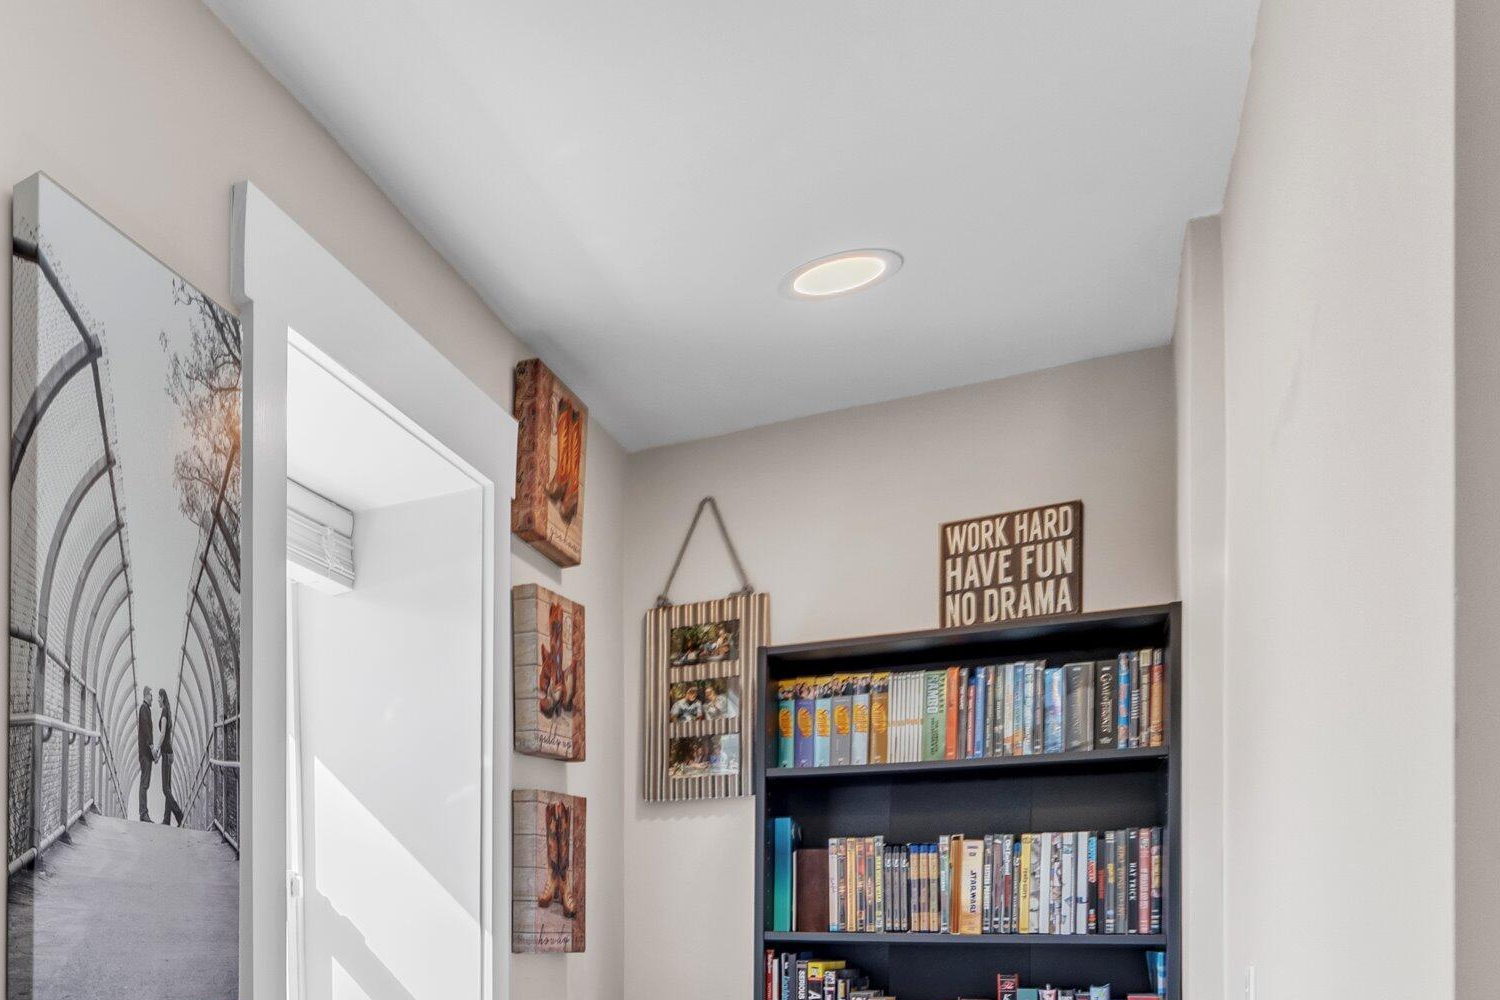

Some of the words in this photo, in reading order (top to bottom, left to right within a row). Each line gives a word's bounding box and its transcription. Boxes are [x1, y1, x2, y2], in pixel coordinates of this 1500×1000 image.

[946, 516, 1009, 555] WORK
[1014, 505, 1073, 545] HARD
[945, 548, 1014, 592] HAVE
[1021, 538, 1074, 581] FUN
[945, 591, 977, 628] NO
[983, 576, 1073, 624] DRAMA
